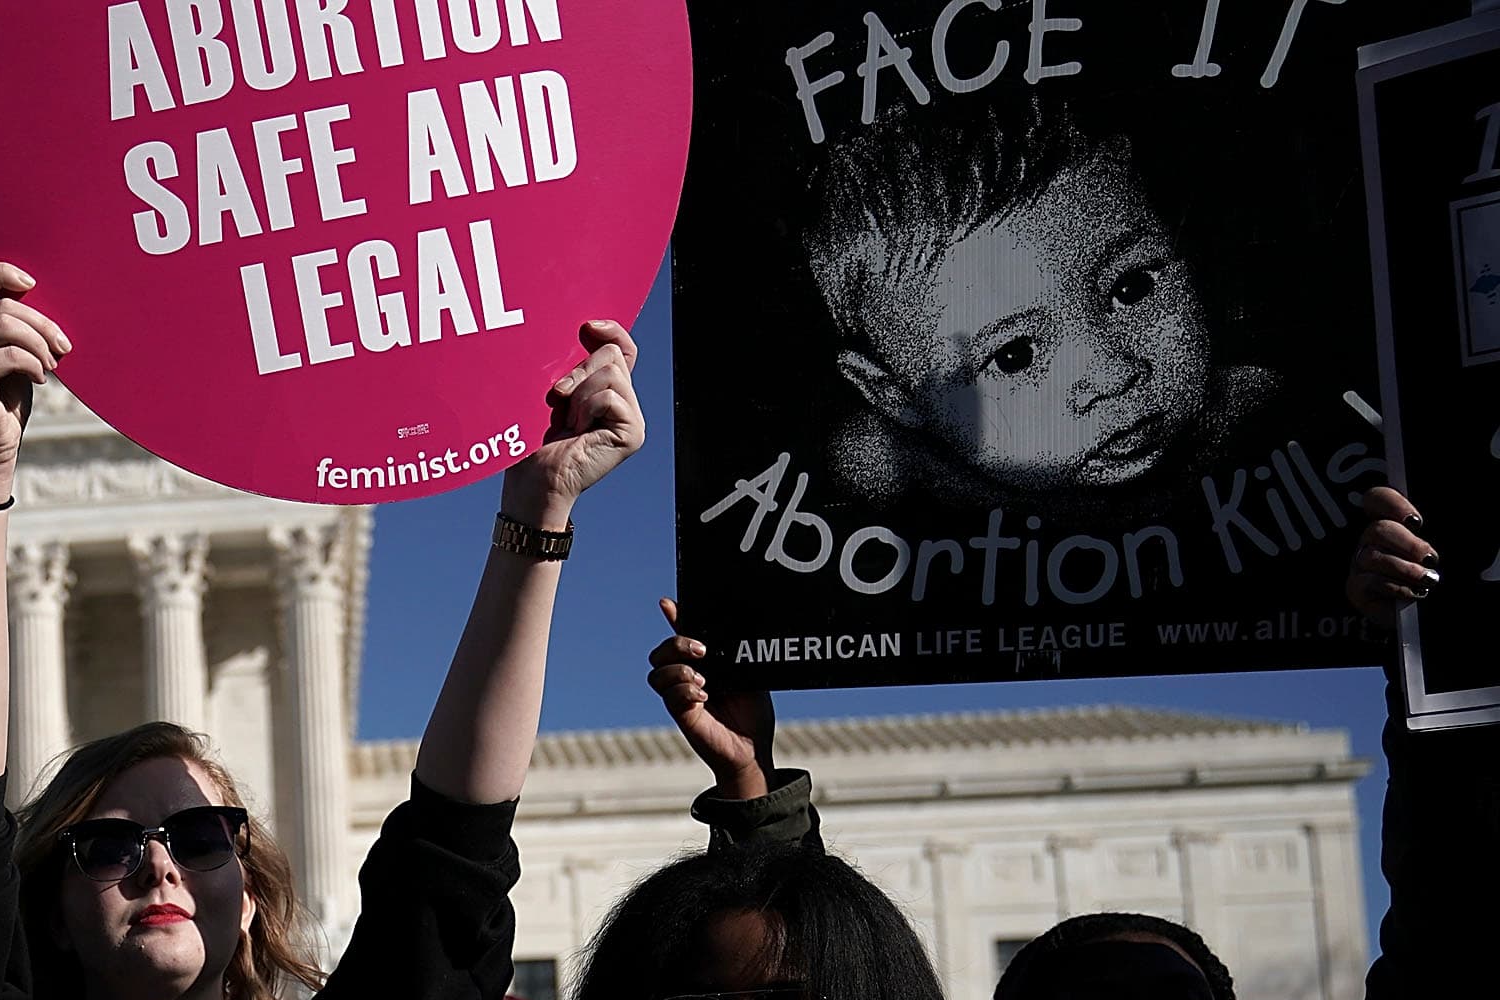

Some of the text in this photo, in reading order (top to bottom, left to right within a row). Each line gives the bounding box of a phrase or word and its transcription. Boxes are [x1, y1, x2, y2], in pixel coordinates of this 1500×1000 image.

[786, 0, 1082, 143] FACE
[123, 70, 578, 255] SAFE AND
[240, 219, 525, 375] LEGAL
[316, 423, 526, 489] feminist.org
[700, 452, 1184, 606] Abortion
[734, 632, 901, 664] AMERICAN
[916, 629, 983, 655] LIFE
[998, 621, 1128, 651] LEAGUE
